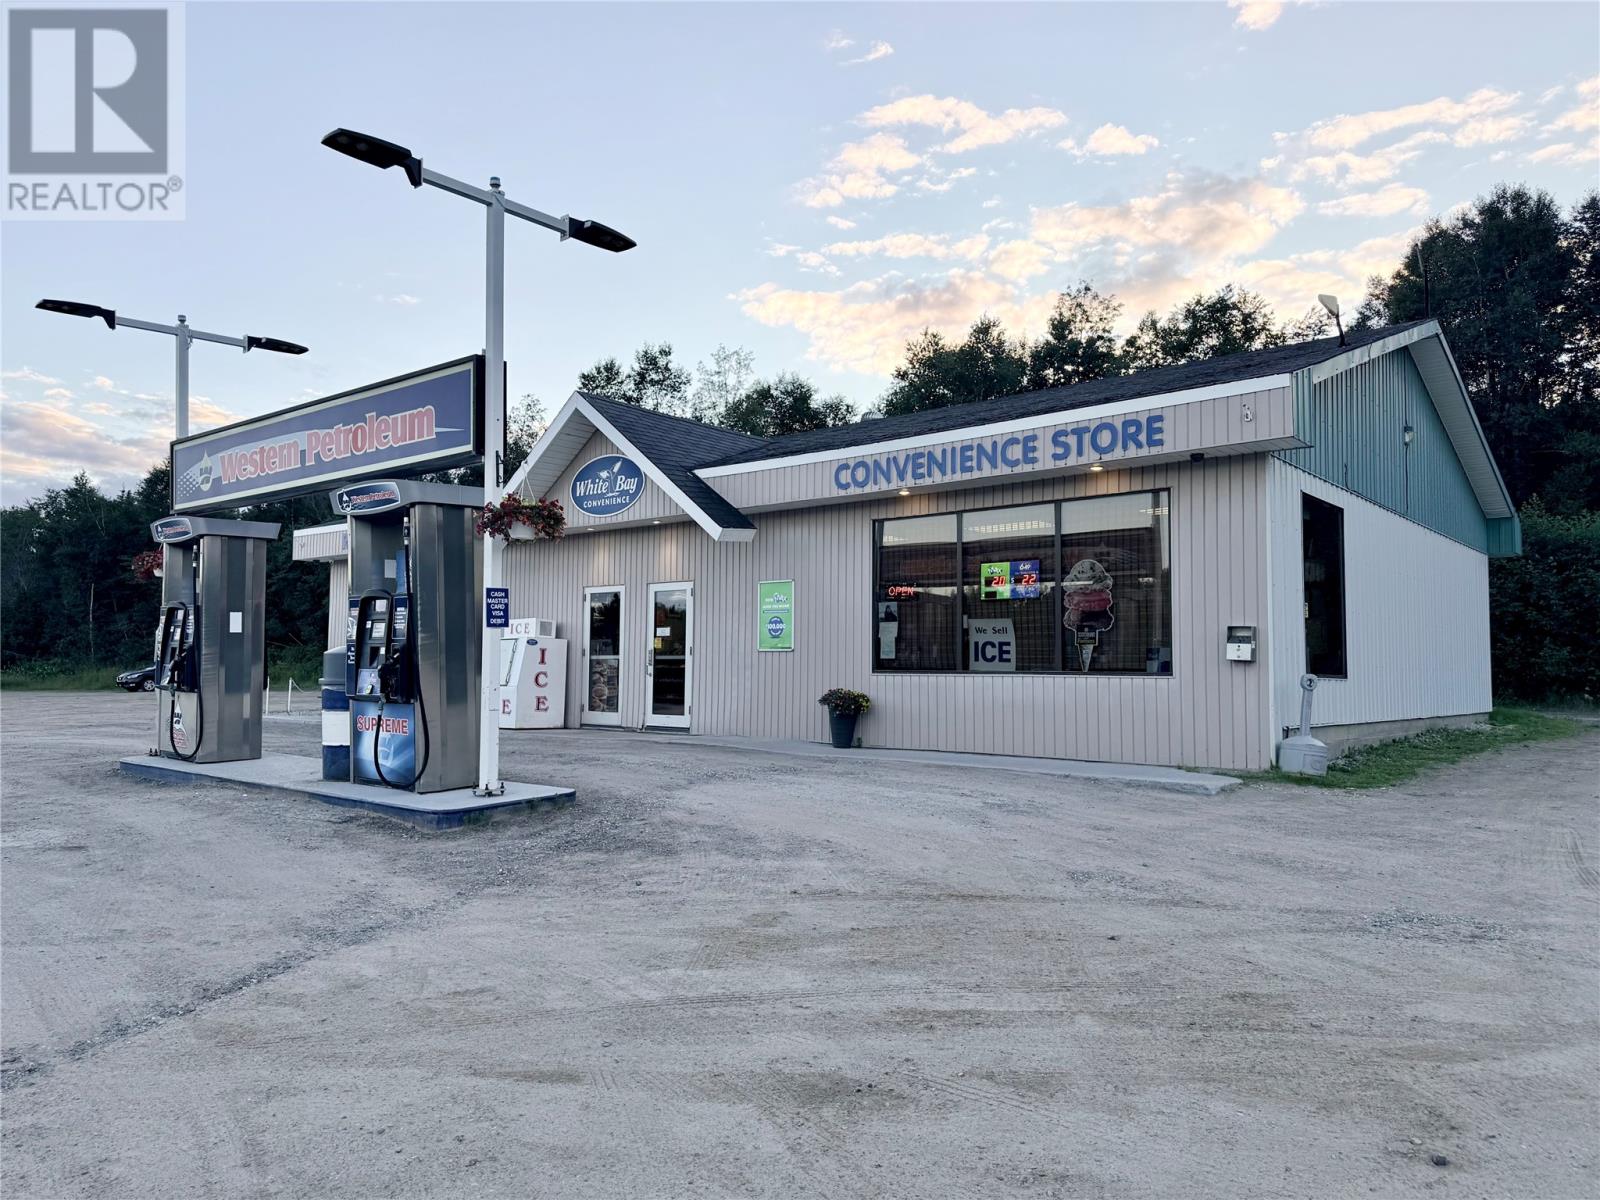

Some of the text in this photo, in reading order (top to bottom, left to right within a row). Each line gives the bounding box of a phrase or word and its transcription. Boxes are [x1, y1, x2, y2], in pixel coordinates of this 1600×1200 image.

[219, 405, 437, 484] Western Petroleum
[833, 414, 1165, 490] CONVENIENCE STORE
[576, 475, 638, 497] White Bay
[583, 496, 630, 508] CONVENIENCE
[1022, 574, 1037, 585] 22
[888, 586, 914, 596] OPEN
[510, 623, 530, 635] ICE
[974, 626, 1008, 635] We Sell
[973, 640, 1012, 663] ICE
[357, 714, 409, 736] SUPREME
